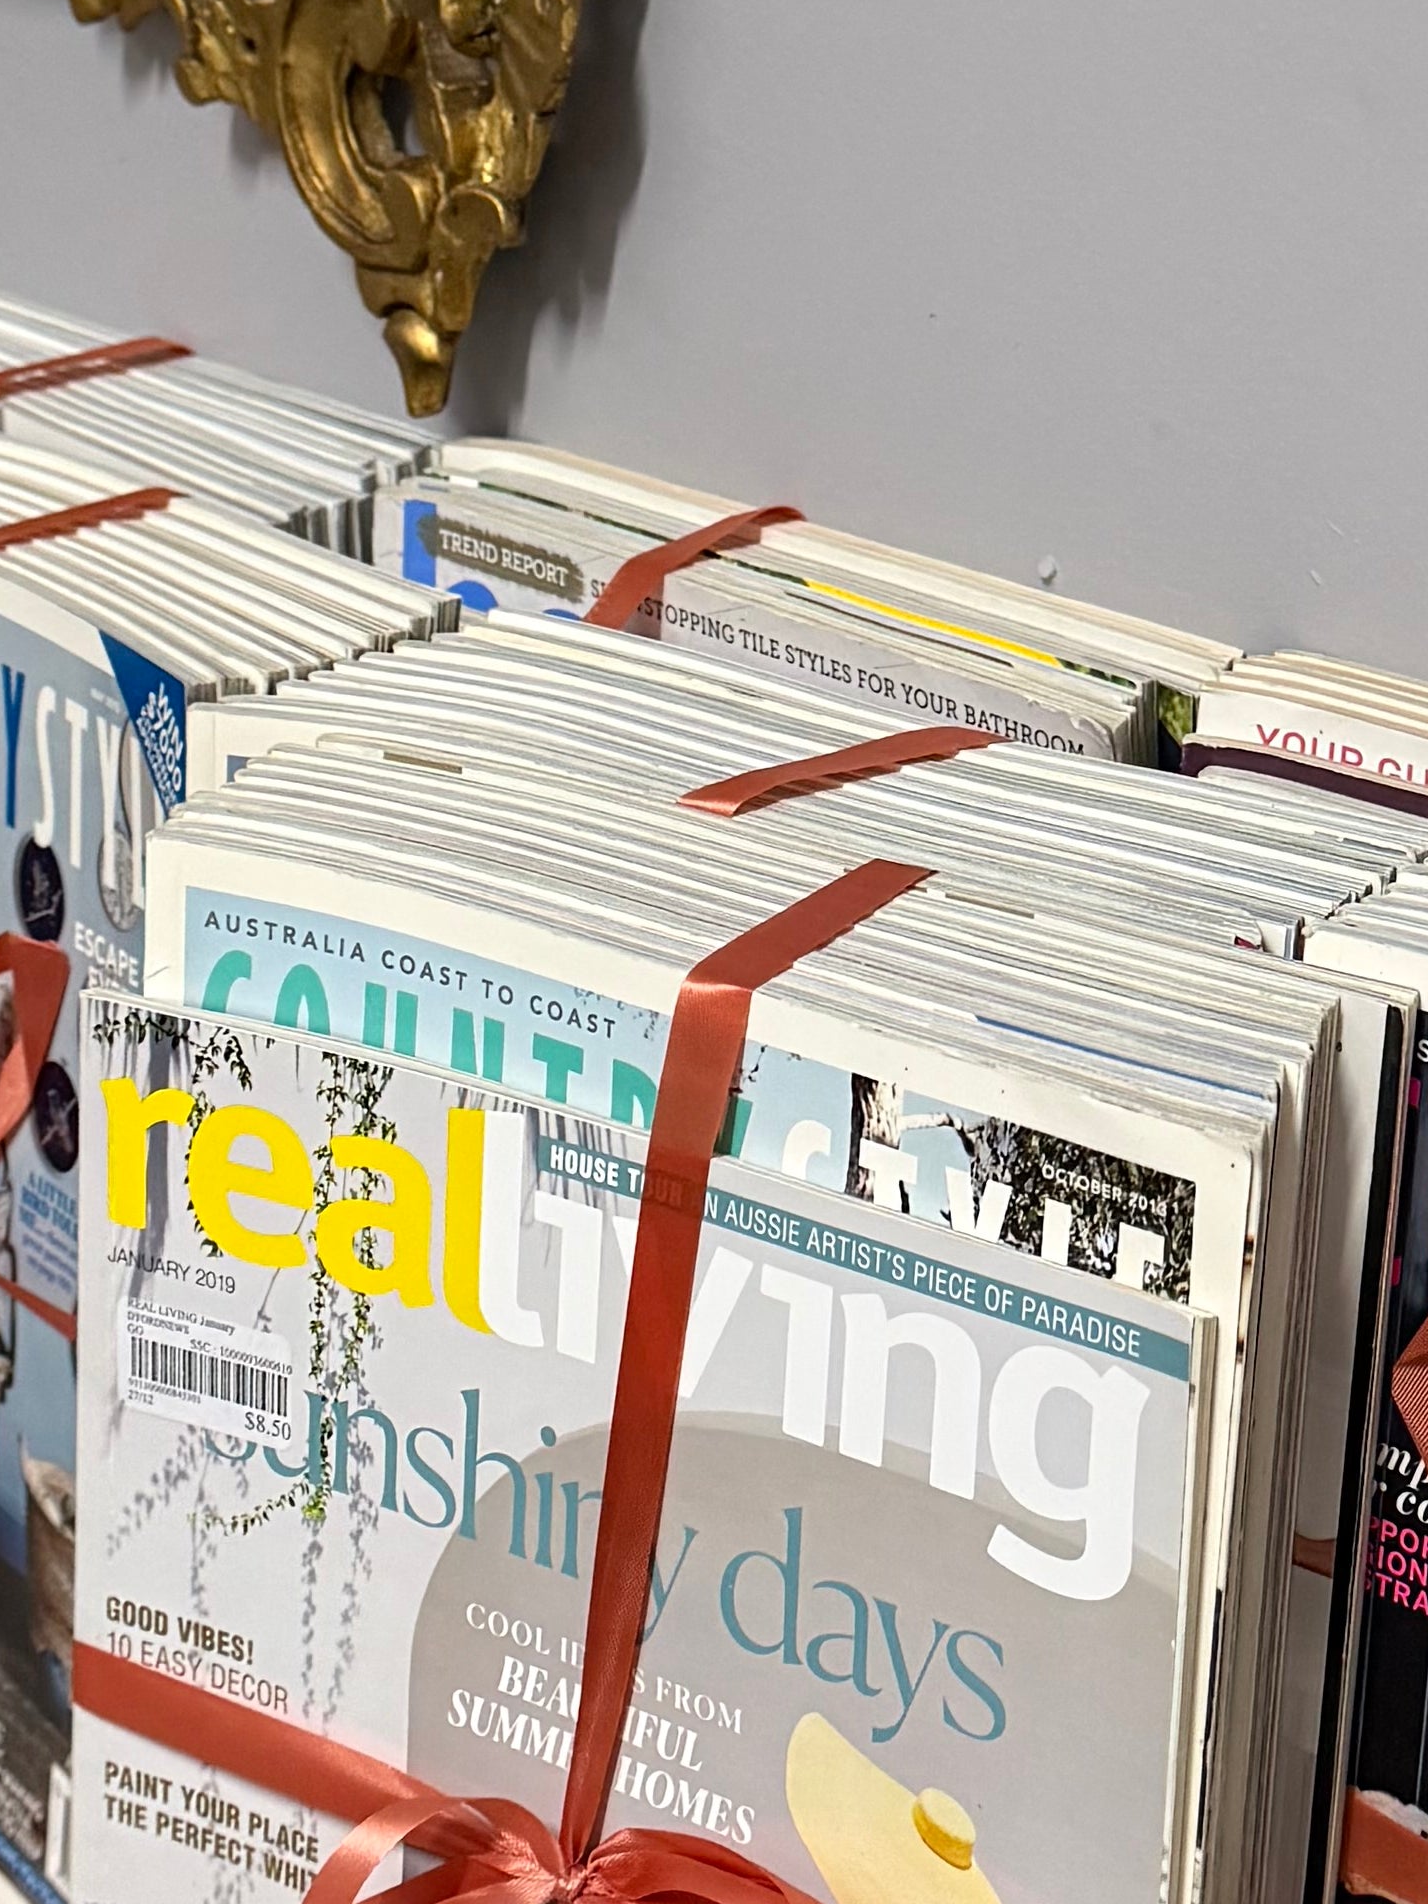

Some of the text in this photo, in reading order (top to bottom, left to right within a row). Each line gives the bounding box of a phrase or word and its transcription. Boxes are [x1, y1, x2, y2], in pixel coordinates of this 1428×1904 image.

[439, 528, 569, 588] TREND REPORT
[590, 578, 735, 645] SSTOPPING
[738, 627, 781, 660] TILE
[784, 643, 853, 685] STYLES
[857, 667, 897, 700] FOR
[900, 682, 959, 721] YOUR
[74, 920, 139, 989] ESCAPE
[204, 908, 618, 1041] AUSTRALIA COAST TO COAST
[1041, 1163, 1122, 1203] OCTOBER
[107, 1247, 237, 1295] JANUARY 2019
[550, 1144, 619, 1187] HOUSE
[724, 1200, 800, 1247] AUSSIE
[806, 1227, 906, 1281] ARTIST'S
[914, 1260, 977, 1305] PIECE
[984, 1284, 1014, 1314] OF
[1021, 1295, 1141, 1359] PARADISE
[99, 1076, 495, 1335] real
[483, 1109, 1151, 1602] living
[127, 1296, 156, 1314] REAL
[158, 1302, 198, 1325] LIVING
[244, 1411, 293, 1442] $8.50
[206, 1388, 1008, 1744] unshiny days
[105, 1596, 254, 1667] GOOD VIBES!
[106, 1629, 290, 1716] 10 EASY DECOR
[465, 1602, 550, 1656] COOL
[655, 1676, 744, 1736] FROM
[104, 1760, 319, 1864] PAINT YOUR PLACE
[104, 1793, 148, 1832] THE
[155, 1810, 257, 1873] PERFECT
[613, 1755, 756, 1846] HOMES
